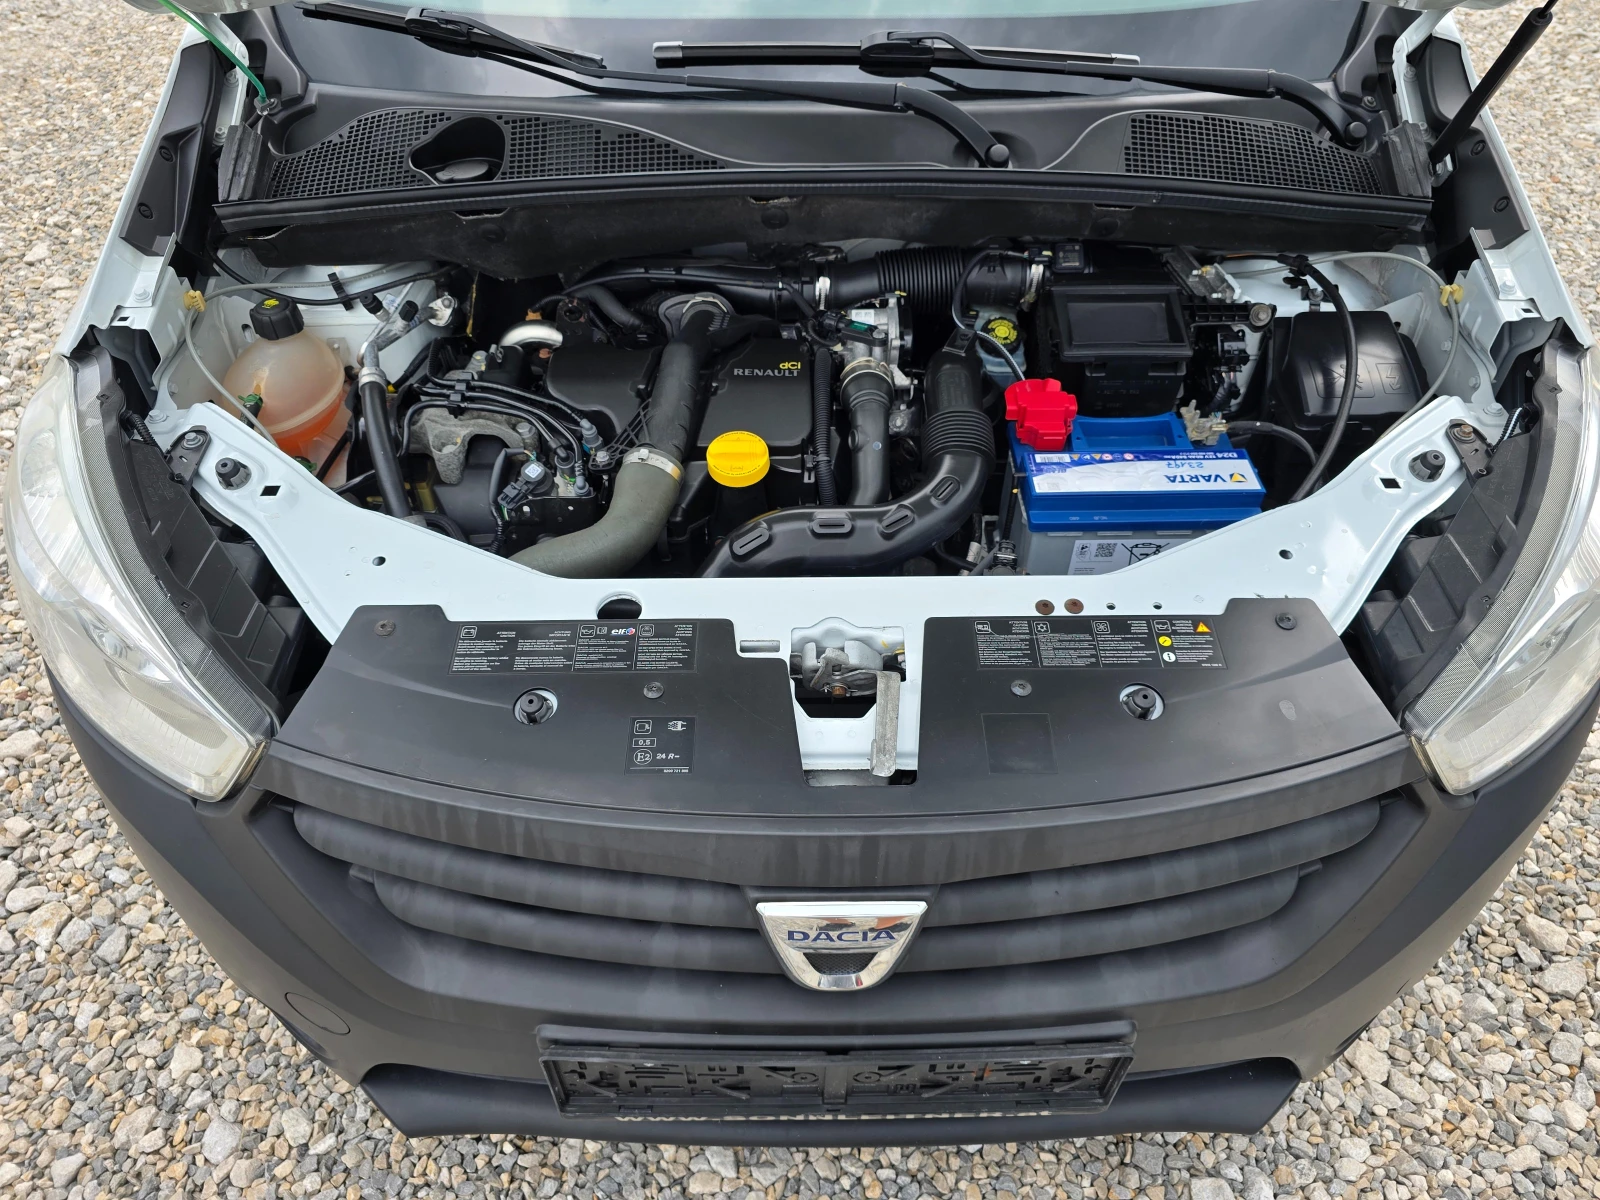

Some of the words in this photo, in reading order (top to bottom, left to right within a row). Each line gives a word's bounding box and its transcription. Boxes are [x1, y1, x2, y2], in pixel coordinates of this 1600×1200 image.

[733, 368, 801, 377] RENAULT
[1163, 474, 1228, 484] VARTA
[636, 752, 651, 762] E2
[656, 752, 666, 760] 24
[787, 929, 896, 943] DACIA
